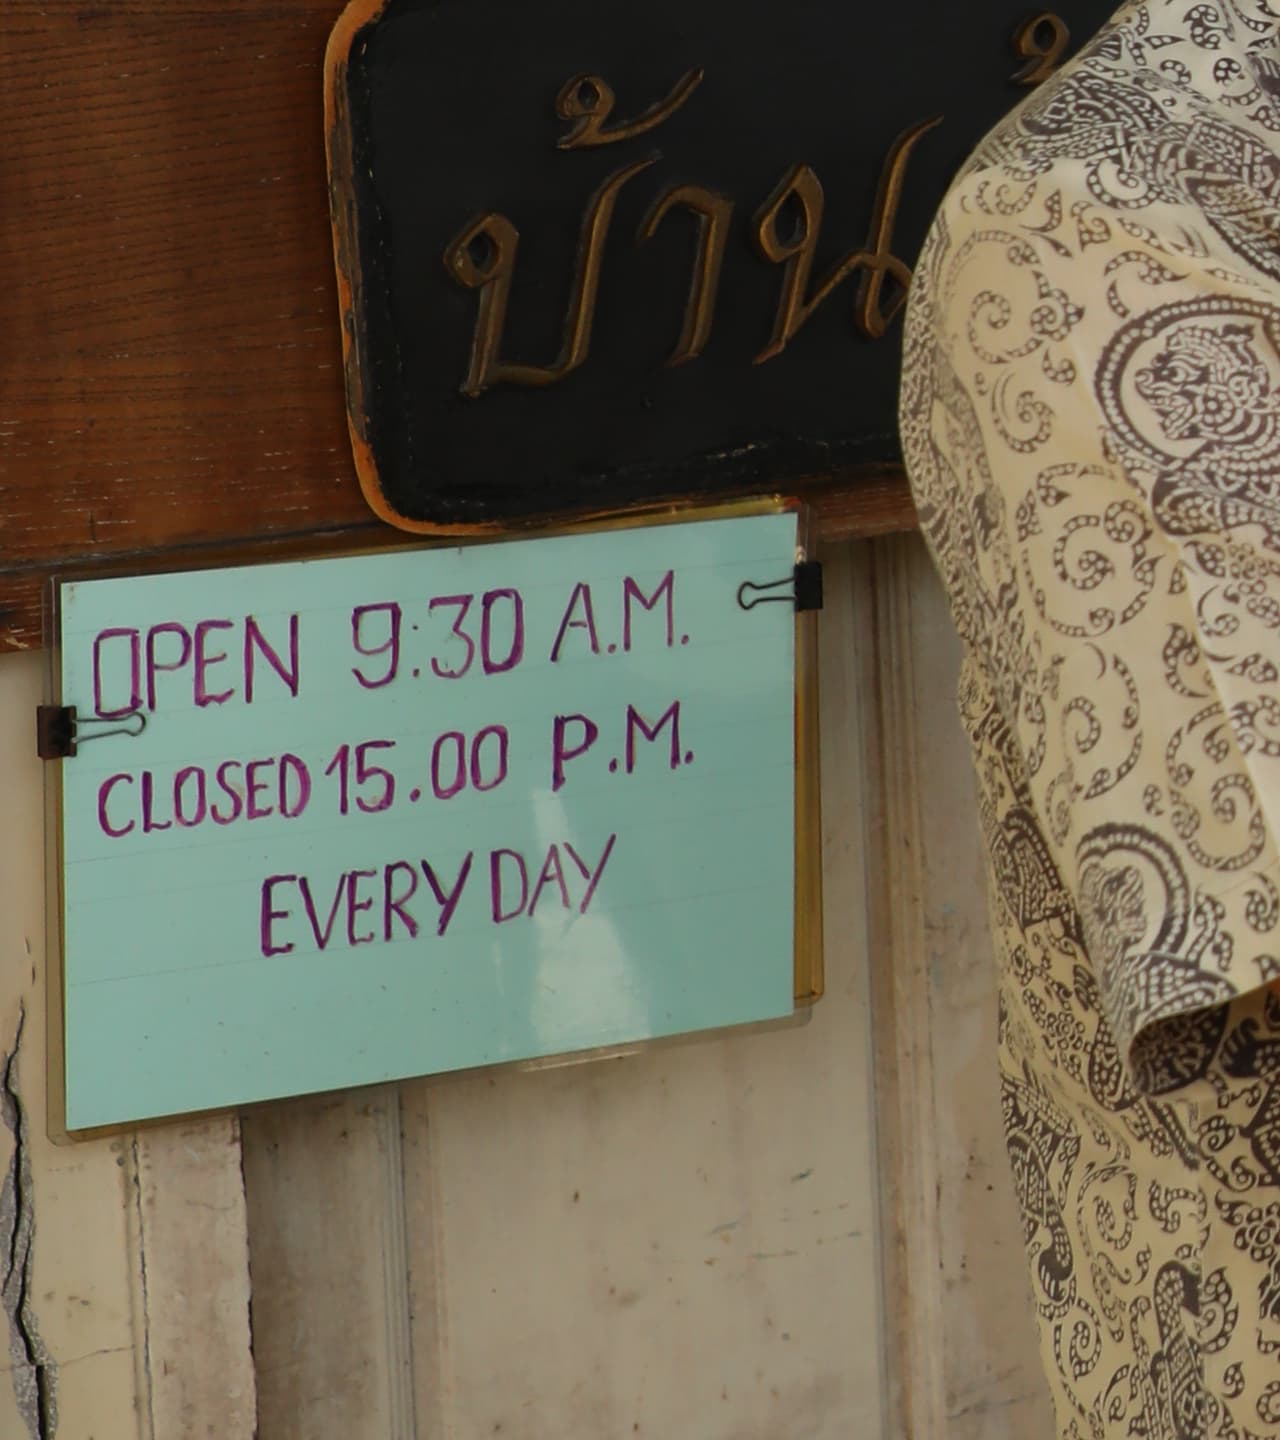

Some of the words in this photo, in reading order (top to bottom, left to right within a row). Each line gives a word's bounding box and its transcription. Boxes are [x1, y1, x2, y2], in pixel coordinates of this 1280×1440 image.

[92, 613, 301, 719] OPEN
[350, 586, 526, 691] 9:30
[549, 568, 692, 663] A.M.
[96, 752, 312, 839] CLOSED
[324, 722, 510, 816] 15.00
[552, 699, 695, 792] P.M.
